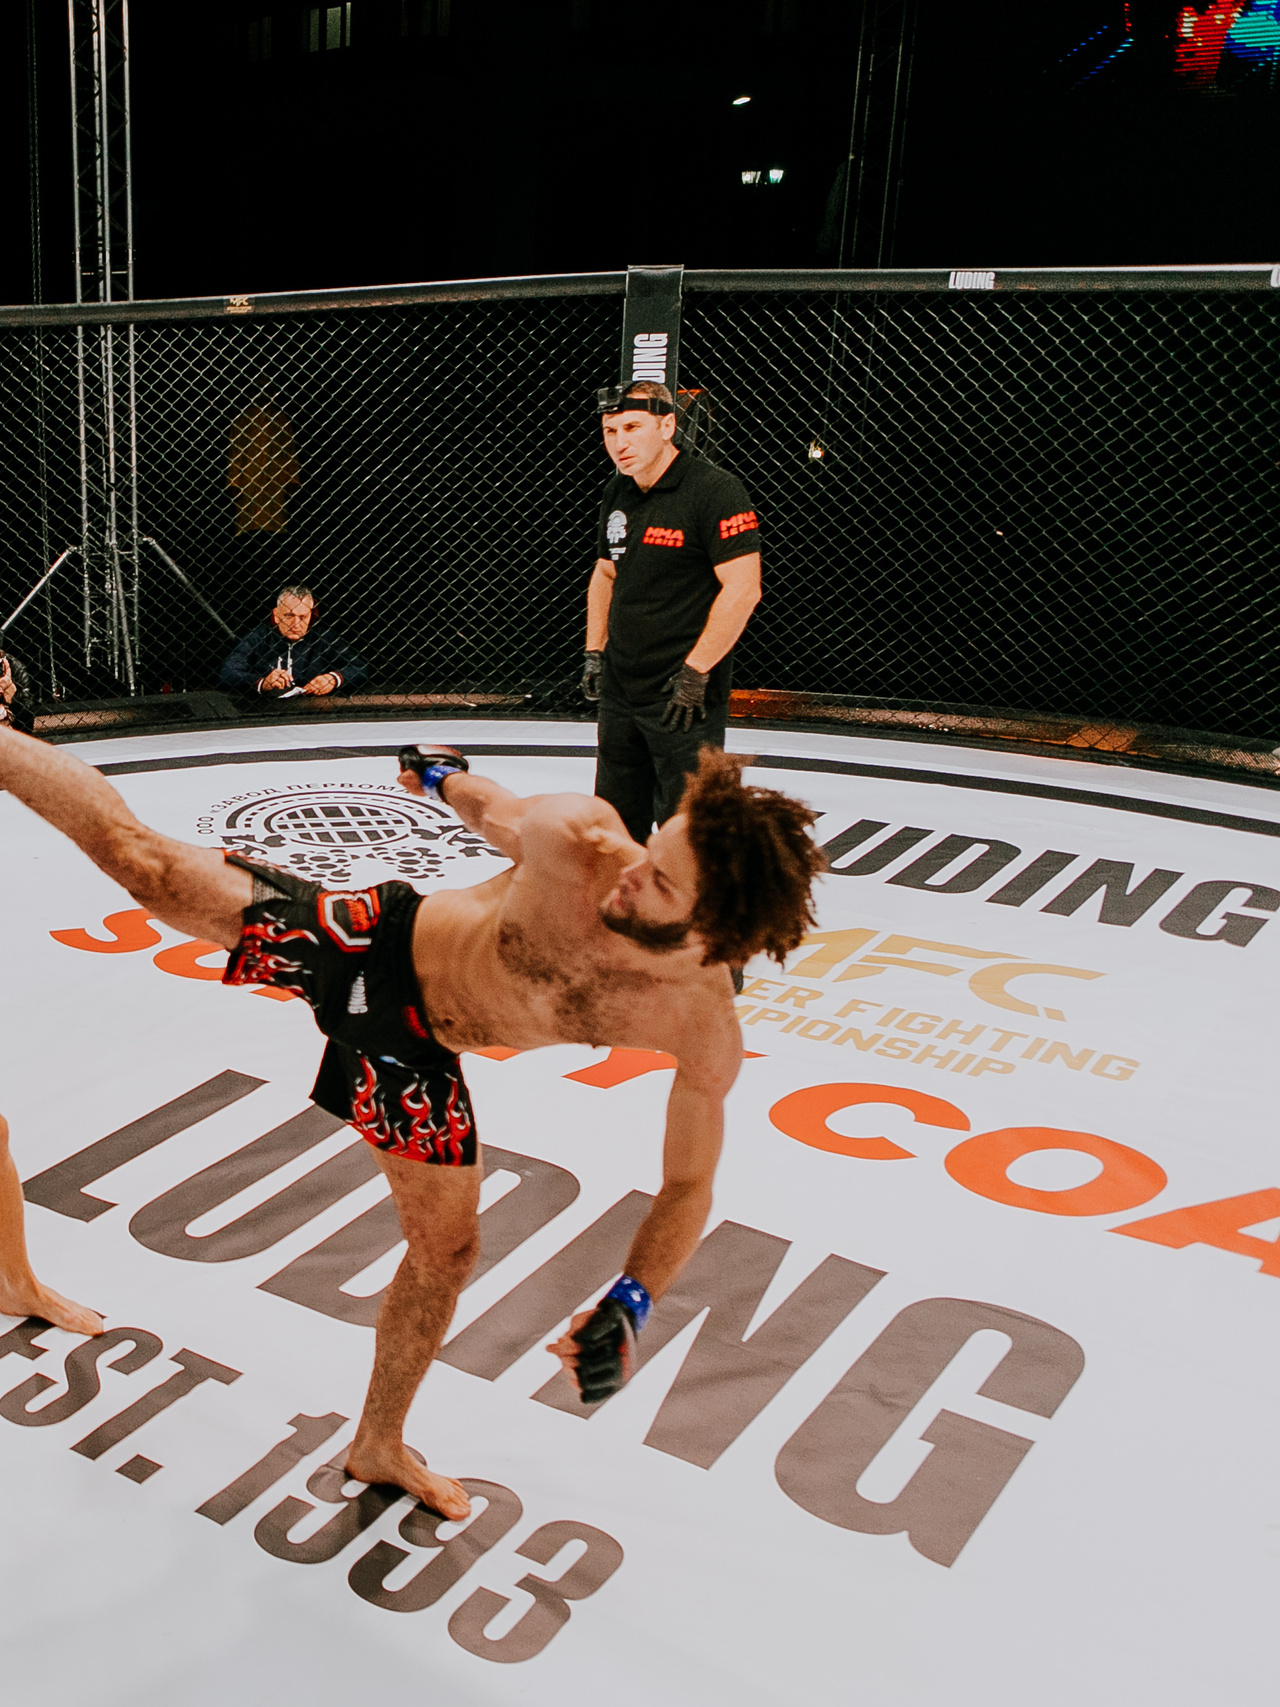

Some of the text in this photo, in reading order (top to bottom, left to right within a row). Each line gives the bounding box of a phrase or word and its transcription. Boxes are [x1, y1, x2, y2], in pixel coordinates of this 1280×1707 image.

[949, 271, 996, 289] LUDING
[632, 333, 668, 384] DING
[642, 536, 684, 548] SERIES
[644, 526, 684, 541] MMA
[814, 811, 1280, 948] UDING
[834, 998, 1142, 1083] FIGHTING
[21, 1068, 1085, 1568] LUDING
[194, 1411, 625, 1664] 1993
